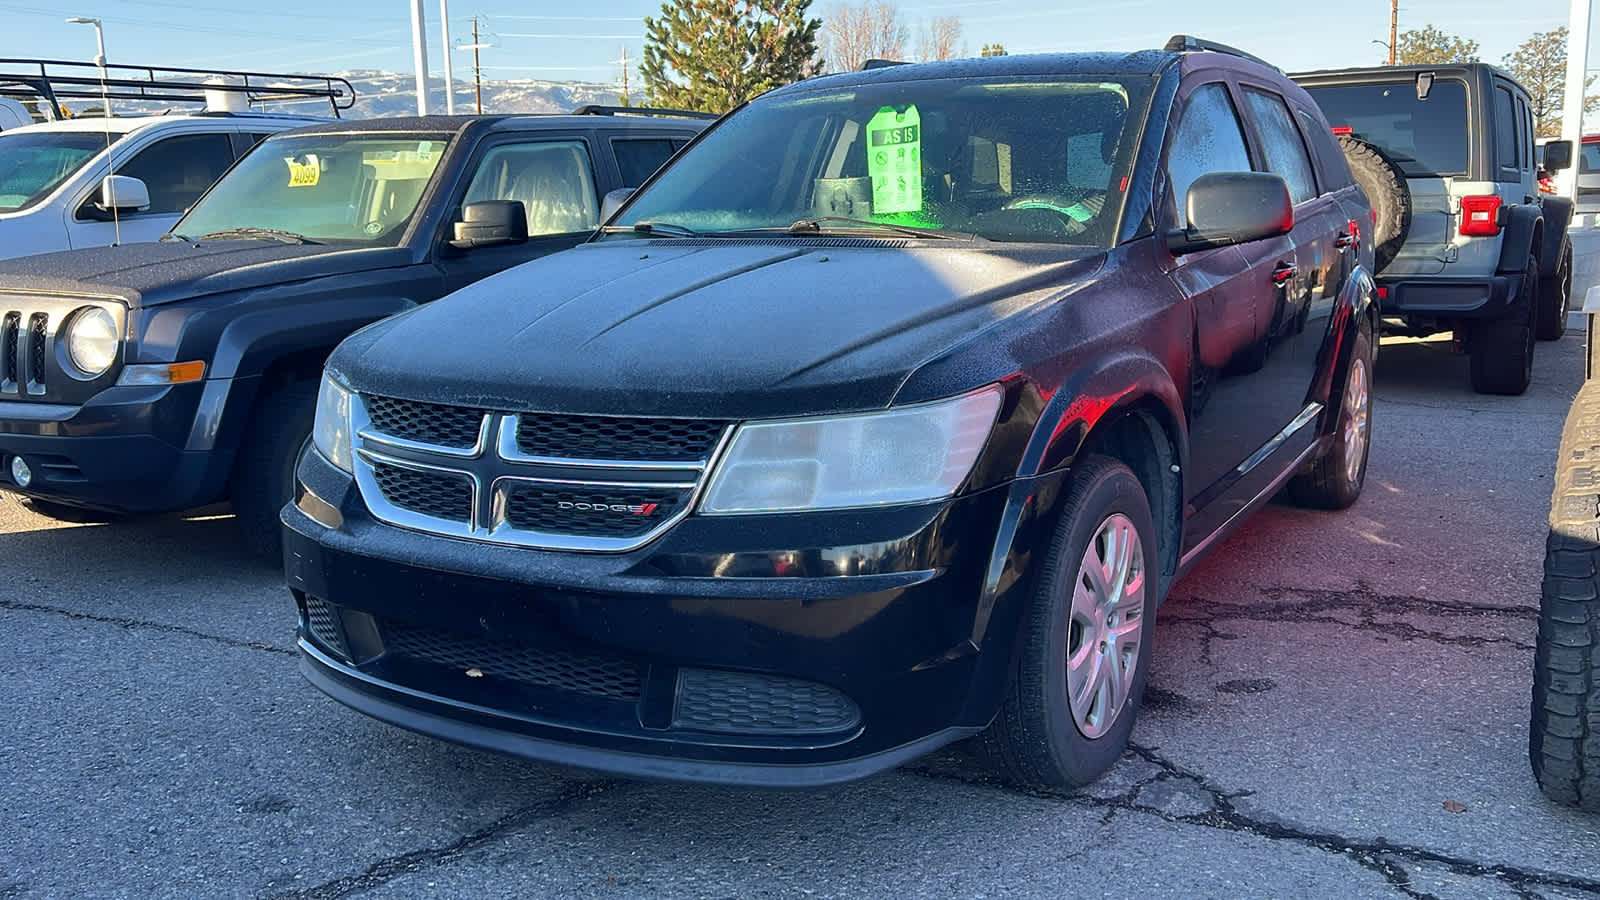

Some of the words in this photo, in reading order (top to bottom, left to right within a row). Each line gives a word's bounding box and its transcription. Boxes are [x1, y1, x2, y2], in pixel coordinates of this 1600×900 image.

[884, 129, 901, 145] AS
[904, 127, 913, 142] IS
[558, 501, 644, 513] DODGE
